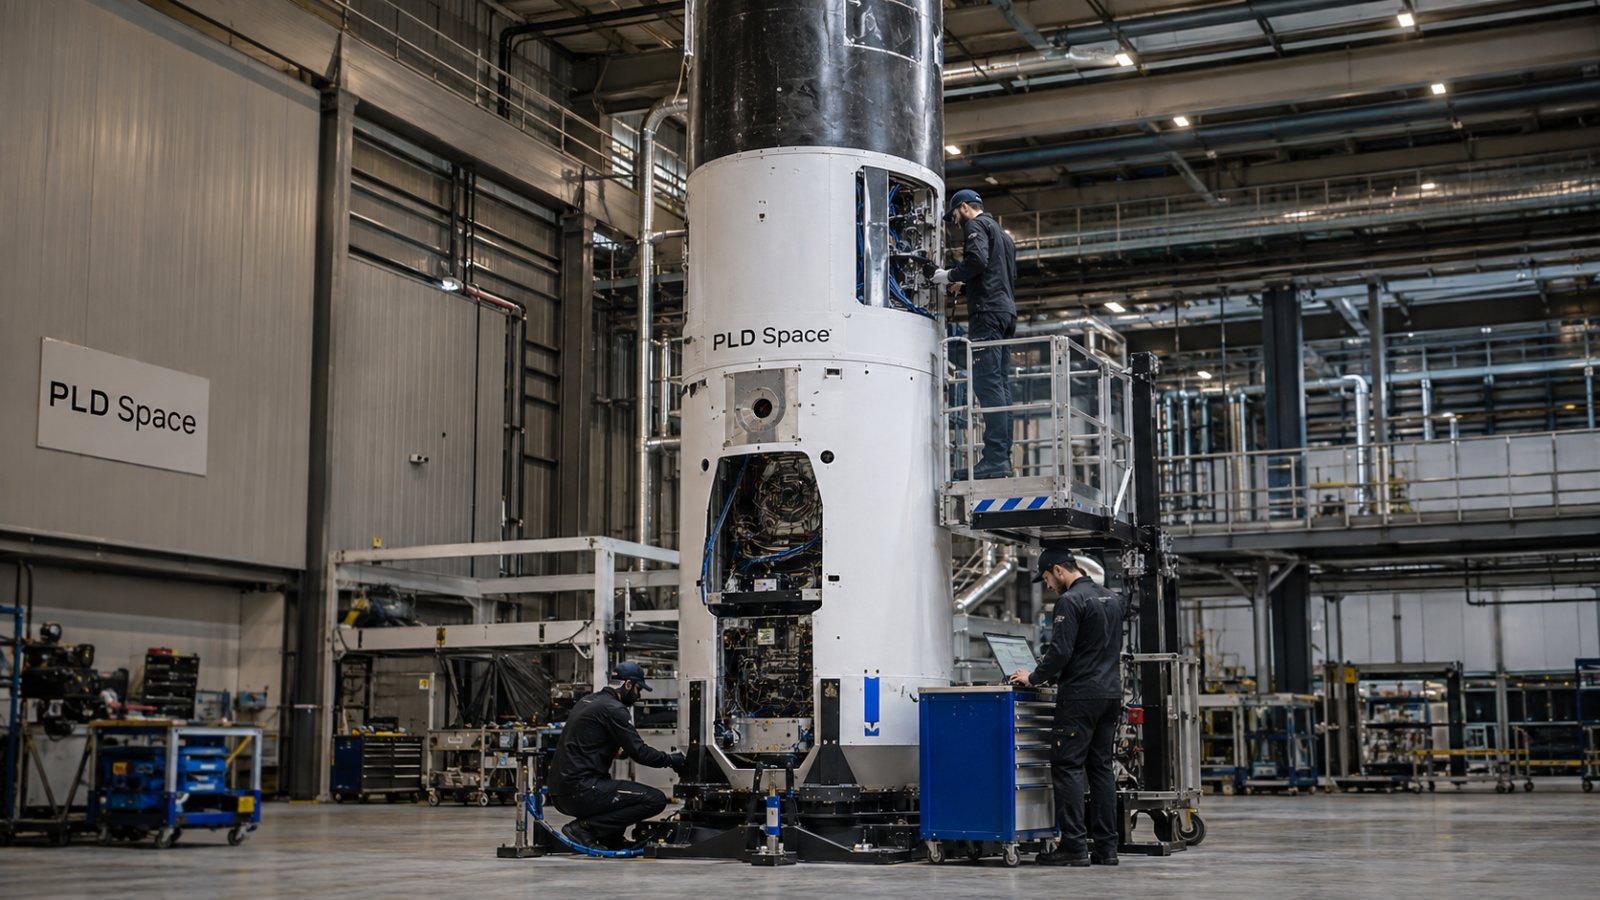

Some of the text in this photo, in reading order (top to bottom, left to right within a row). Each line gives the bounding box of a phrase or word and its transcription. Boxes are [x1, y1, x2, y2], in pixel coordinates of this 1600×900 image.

[713, 327, 830, 351] PLD Space
[49, 380, 197, 435] PLD Space
